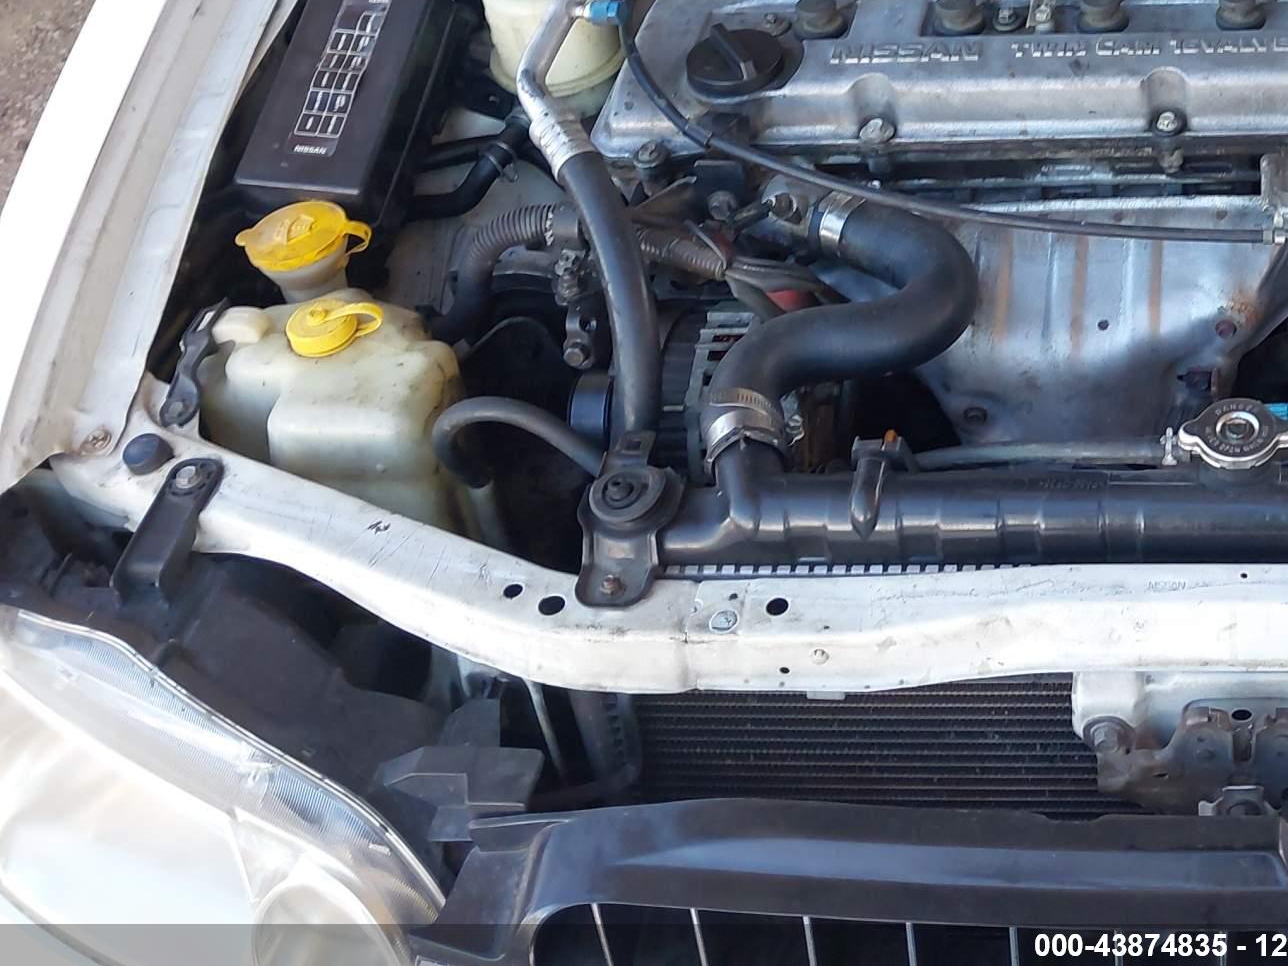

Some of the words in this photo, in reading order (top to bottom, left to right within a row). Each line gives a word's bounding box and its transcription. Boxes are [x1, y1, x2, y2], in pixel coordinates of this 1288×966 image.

[830, 42, 979, 64] NISSAN
[1011, 40, 1086, 57] TWIN
[1096, 36, 1160, 55] CAM
[293, 144, 327, 155] NISSAN
